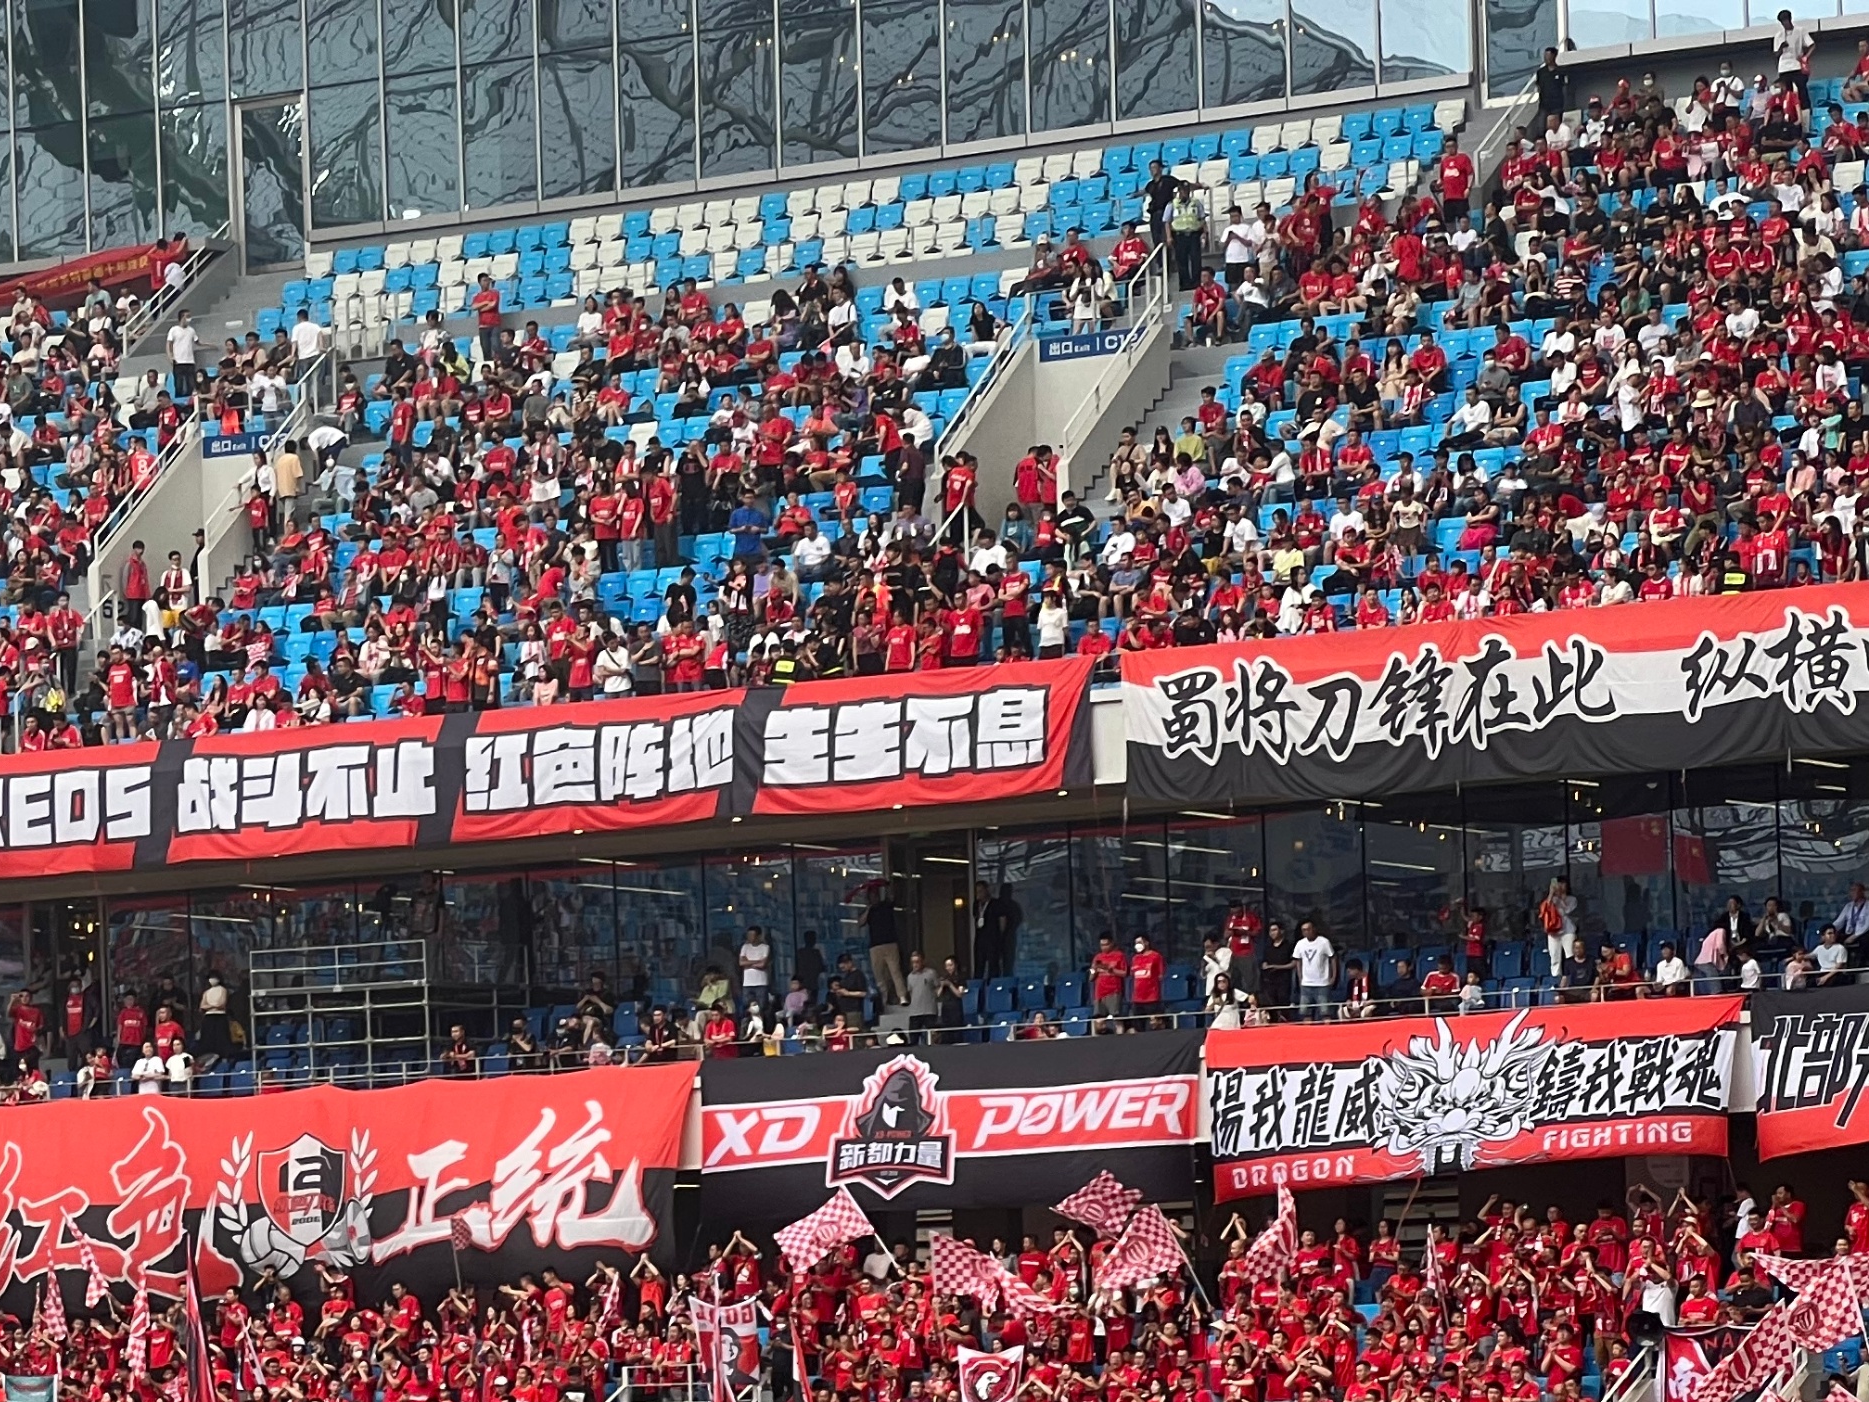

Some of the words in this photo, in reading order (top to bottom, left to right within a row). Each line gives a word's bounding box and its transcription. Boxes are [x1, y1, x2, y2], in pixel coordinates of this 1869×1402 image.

[1049, 341, 1073, 356] 出口
[211, 440, 231, 453] 出口
[1156, 634, 1616, 765] 蜀将刀锋在此
[178, 737, 436, 834] 战斗不止
[464, 709, 734, 812] 红色阵地
[762, 684, 1046, 786] 生生不息
[702, 1103, 821, 1168] XD
[972, 1077, 1194, 1151] POWER
[838, 1141, 942, 1171] 新都力量
[1232, 1155, 1355, 1189] DRAGON
[1543, 1121, 1693, 1151] FIGHTING
